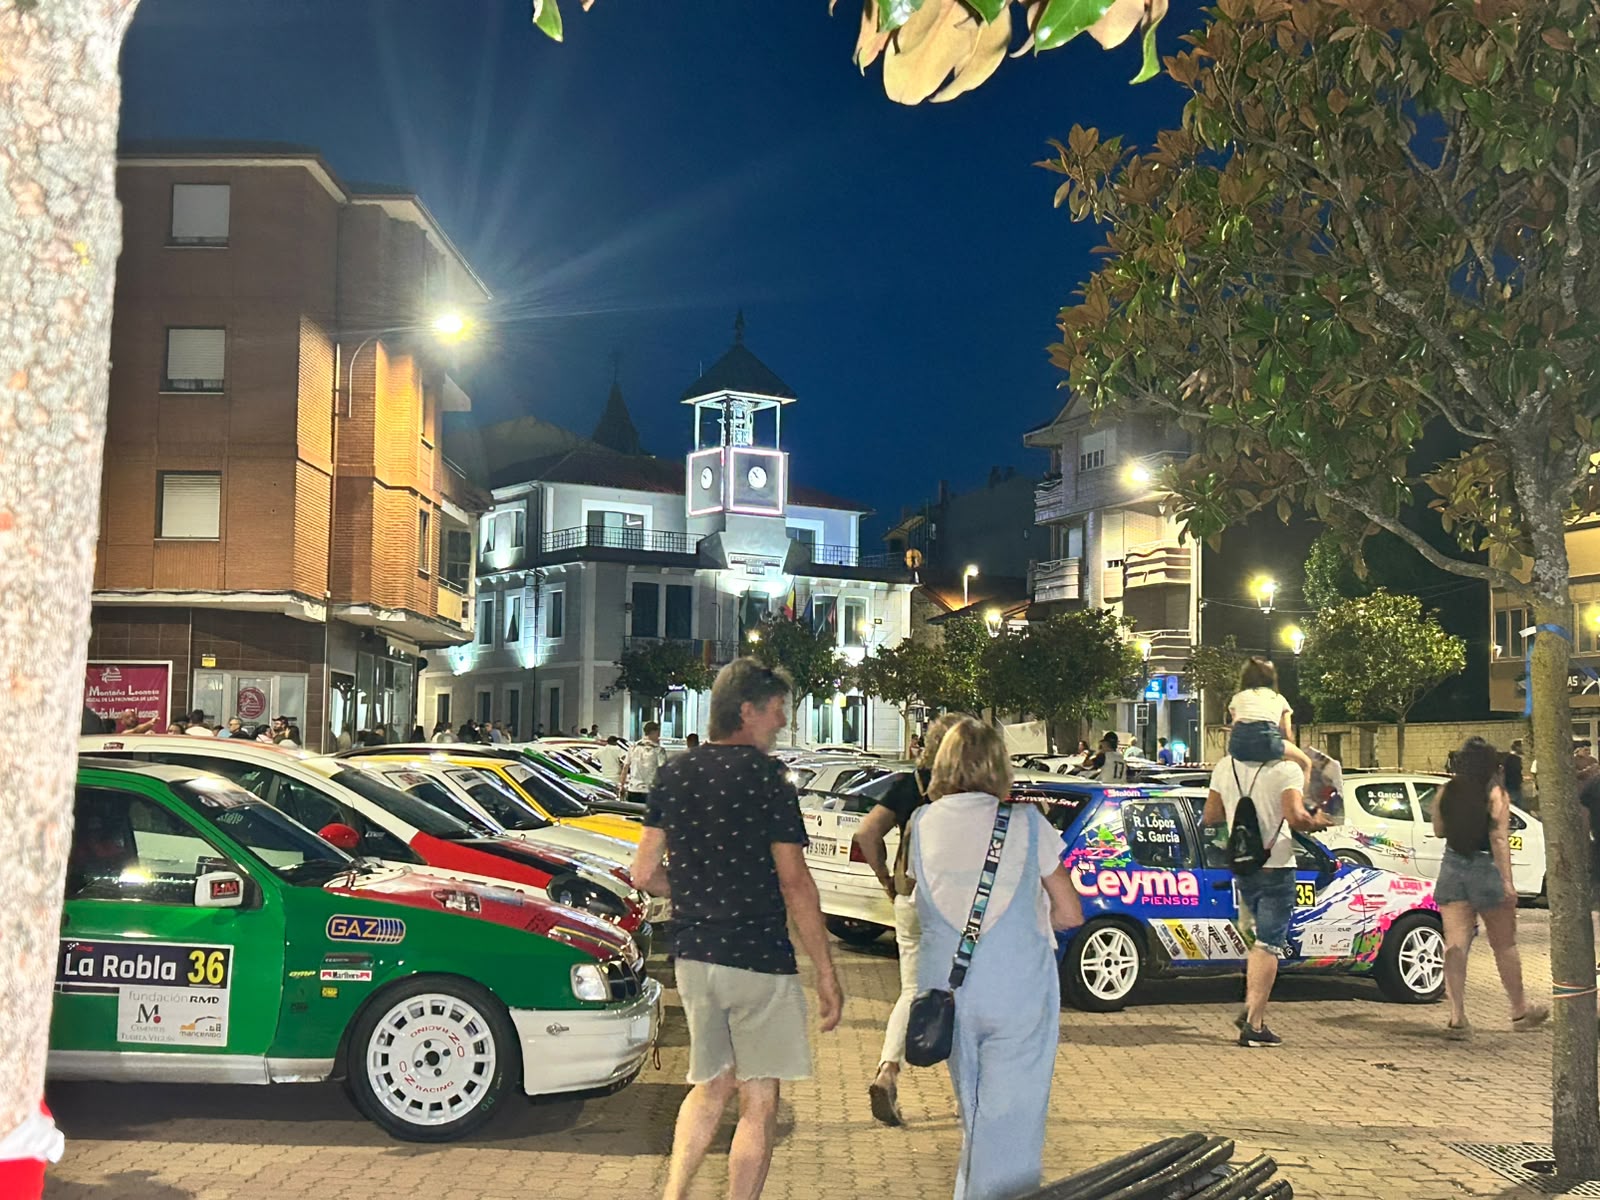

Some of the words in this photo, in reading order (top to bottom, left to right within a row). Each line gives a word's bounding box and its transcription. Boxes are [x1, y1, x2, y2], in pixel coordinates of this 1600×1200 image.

[89, 685, 126, 696] Montaña
[1133, 815, 1145, 828] R.
[1146, 815, 1176, 830] López
[1136, 831, 1147, 843] S.
[1149, 831, 1180, 843] García
[1070, 865, 1199, 905] Ceyma
[1141, 896, 1199, 906] PIENSOS
[1296, 884, 1314, 905] 35
[330, 919, 379, 938] GAZ
[65, 952, 94, 977] La
[102, 954, 177, 980] Robla
[187, 949, 225, 984] 36
[189, 995, 220, 1004] RMD
